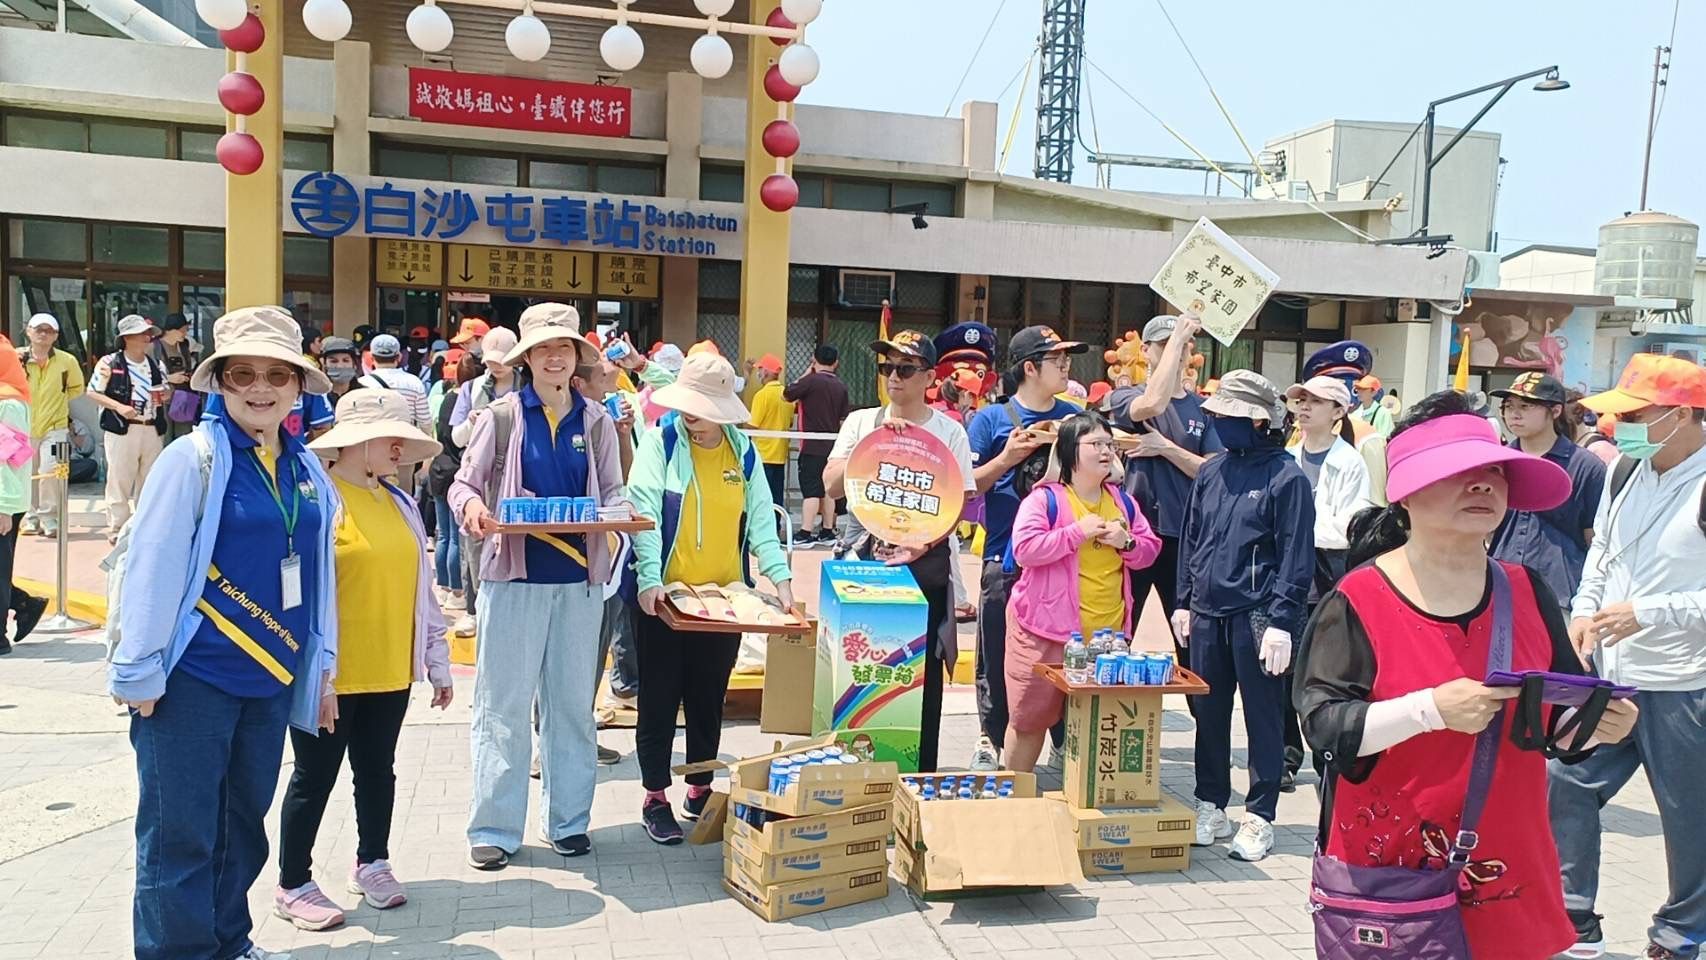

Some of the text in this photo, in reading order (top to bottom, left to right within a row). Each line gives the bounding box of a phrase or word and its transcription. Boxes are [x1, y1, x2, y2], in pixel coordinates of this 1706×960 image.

[364, 182, 642, 250] 白沙屯車站
[645, 204, 738, 233] Baishatun
[644, 232, 716, 256] Station
[610, 256, 646, 270] 購票
[610, 271, 646, 284] 儲值
[1185, 270, 1238, 315] 希望家園
[866, 481, 940, 516] 希望家園
[217, 578, 262, 618] Taichung
[260, 610, 282, 633] Hope
[842, 632, 887, 662] 愛心
[851, 664, 915, 686] 發票箱
[1099, 713, 1118, 782] 竹炭水
[1097, 824, 1130, 832] POCARI
[1097, 831, 1126, 839] SWEAT
